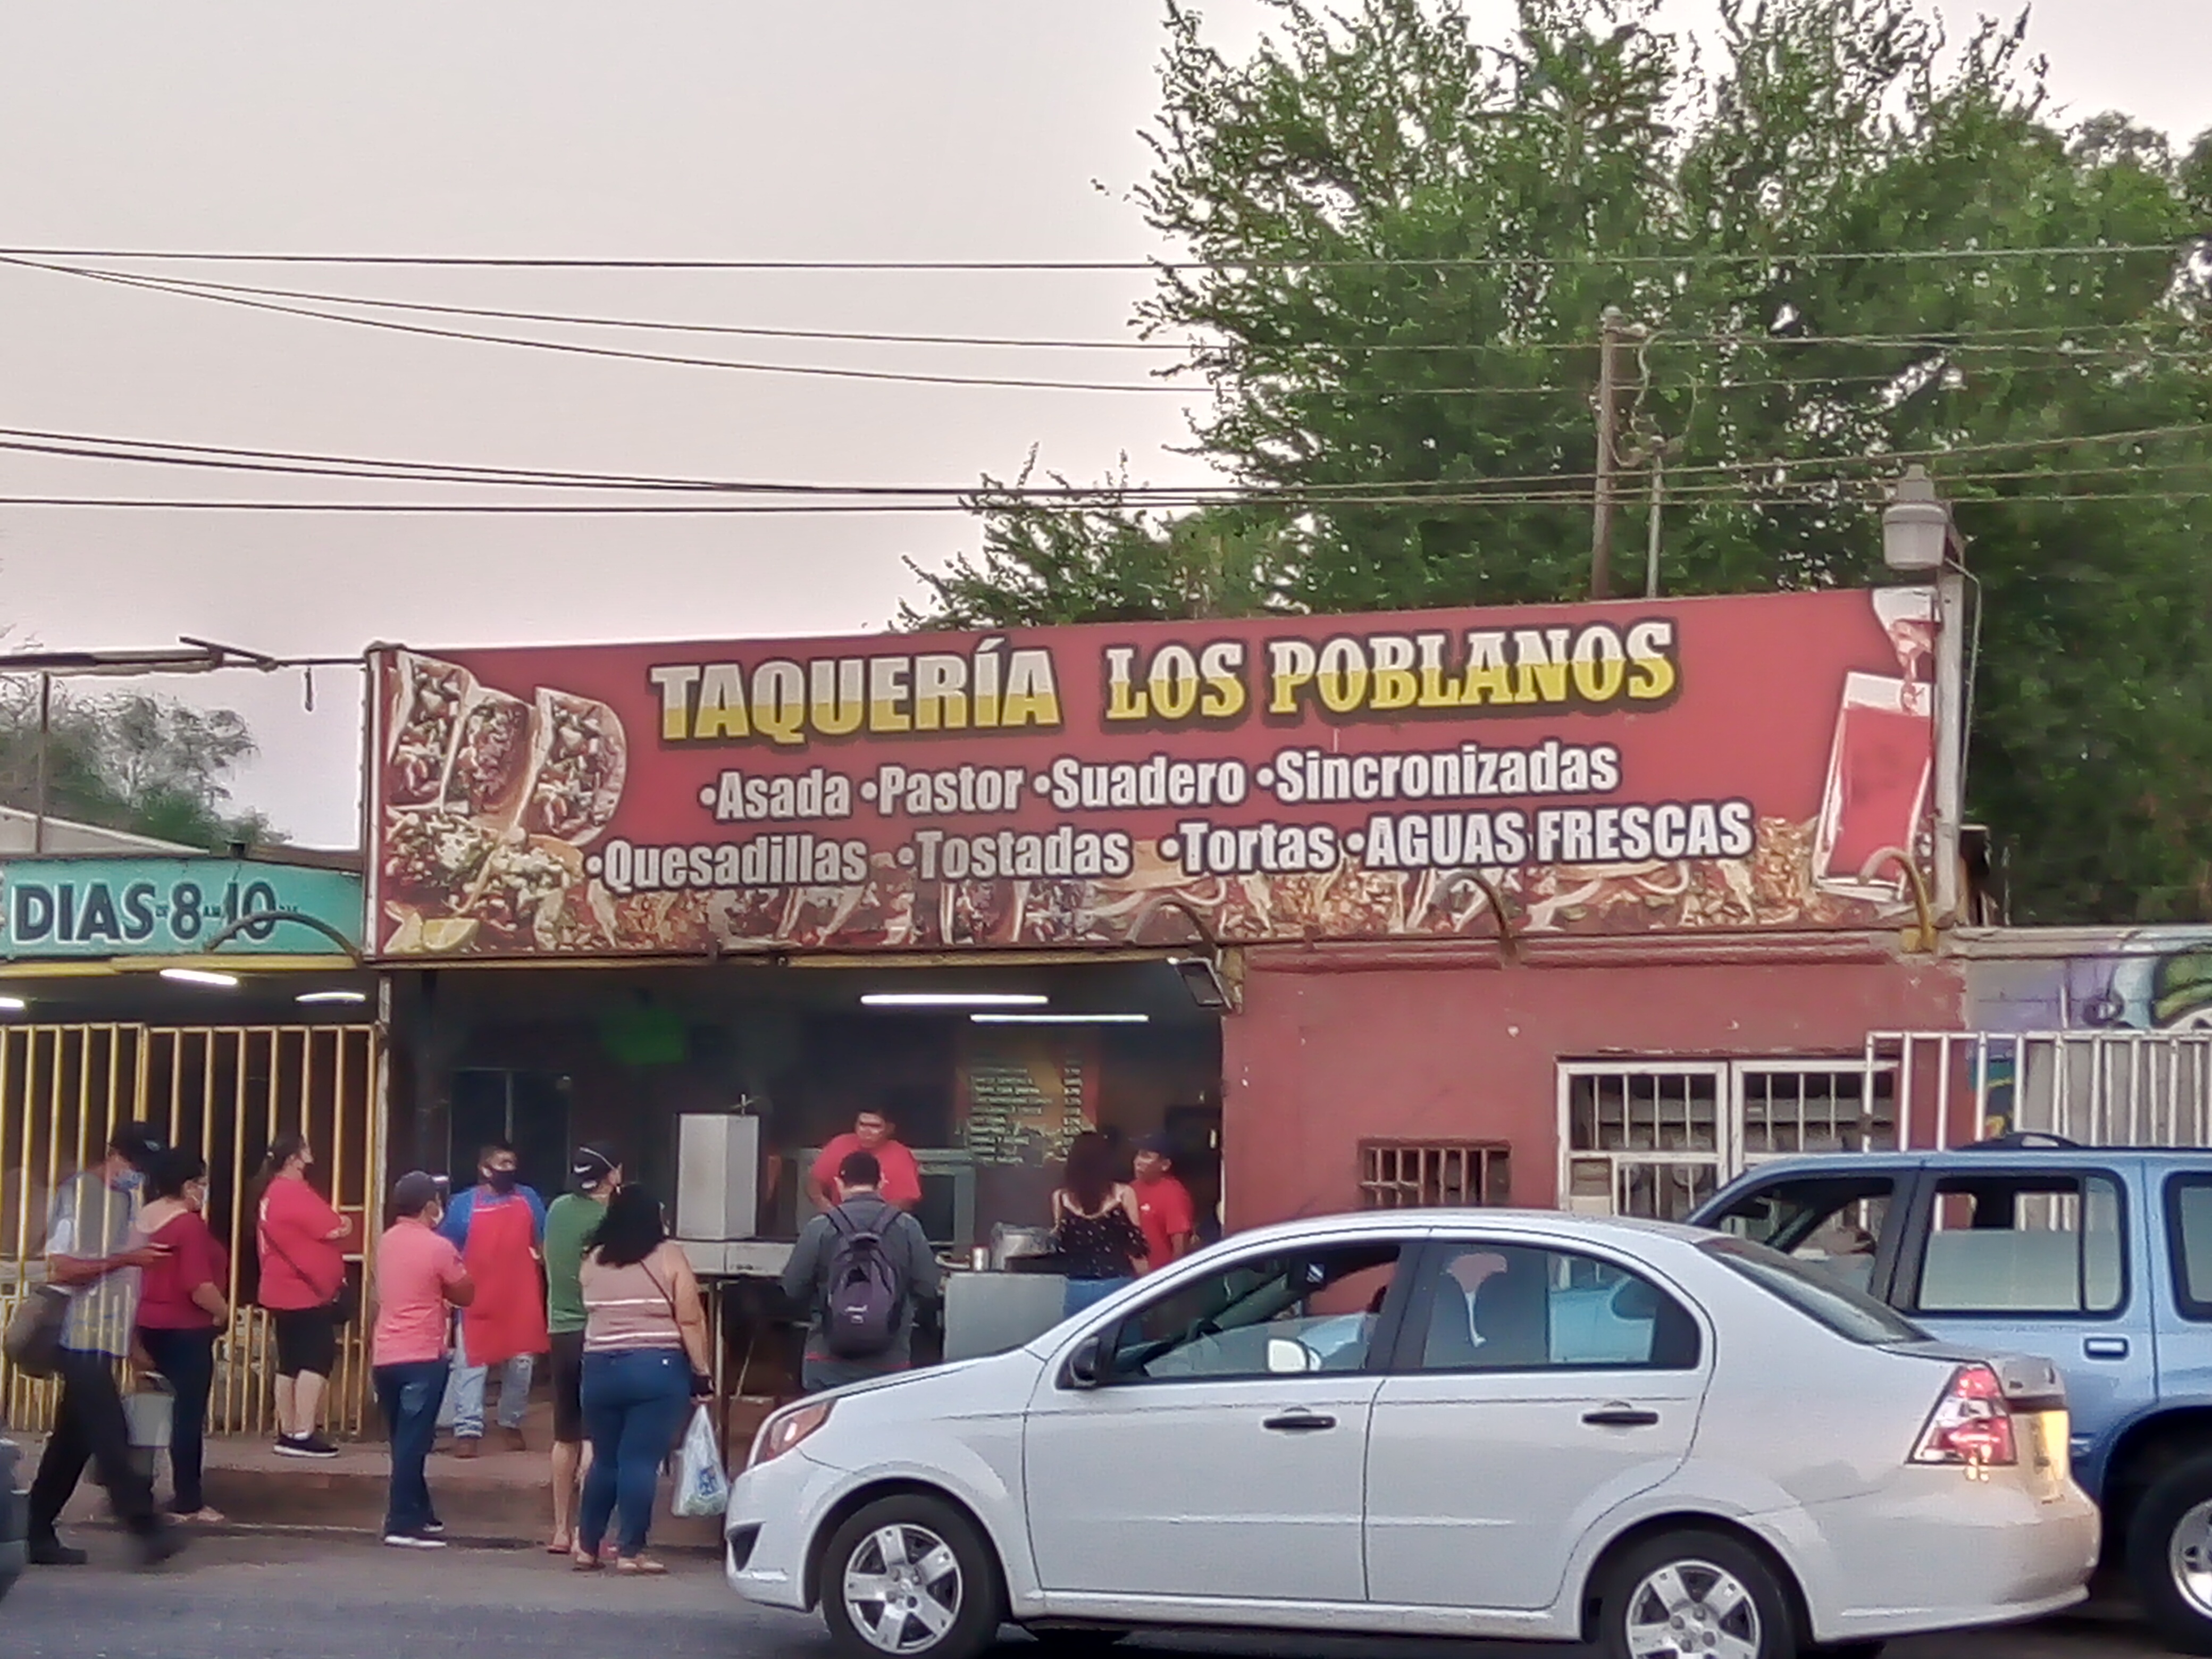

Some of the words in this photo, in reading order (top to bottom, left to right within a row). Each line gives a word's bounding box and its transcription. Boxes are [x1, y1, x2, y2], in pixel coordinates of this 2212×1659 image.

[651, 637, 1060, 744] TAQUERÍA
[1105, 642, 1246, 719] LOS
[1269, 622, 1675, 713] POBLANOS
[716, 768, 851, 820] Asada
[878, 766, 1024, 814] Pastor
[1052, 755, 1246, 808] Suadero
[1276, 741, 1619, 802] Sincronizadas
[604, 834, 867, 893] Quesadillas
[915, 826, 1130, 879] Tostadas
[1179, 823, 1336, 873] Tortas
[1365, 811, 1527, 867] AGUAS
[1537, 802, 1753, 861] FRESCAS
[14, 882, 155, 942] DIAS
[171, 882, 203, 941] 8
